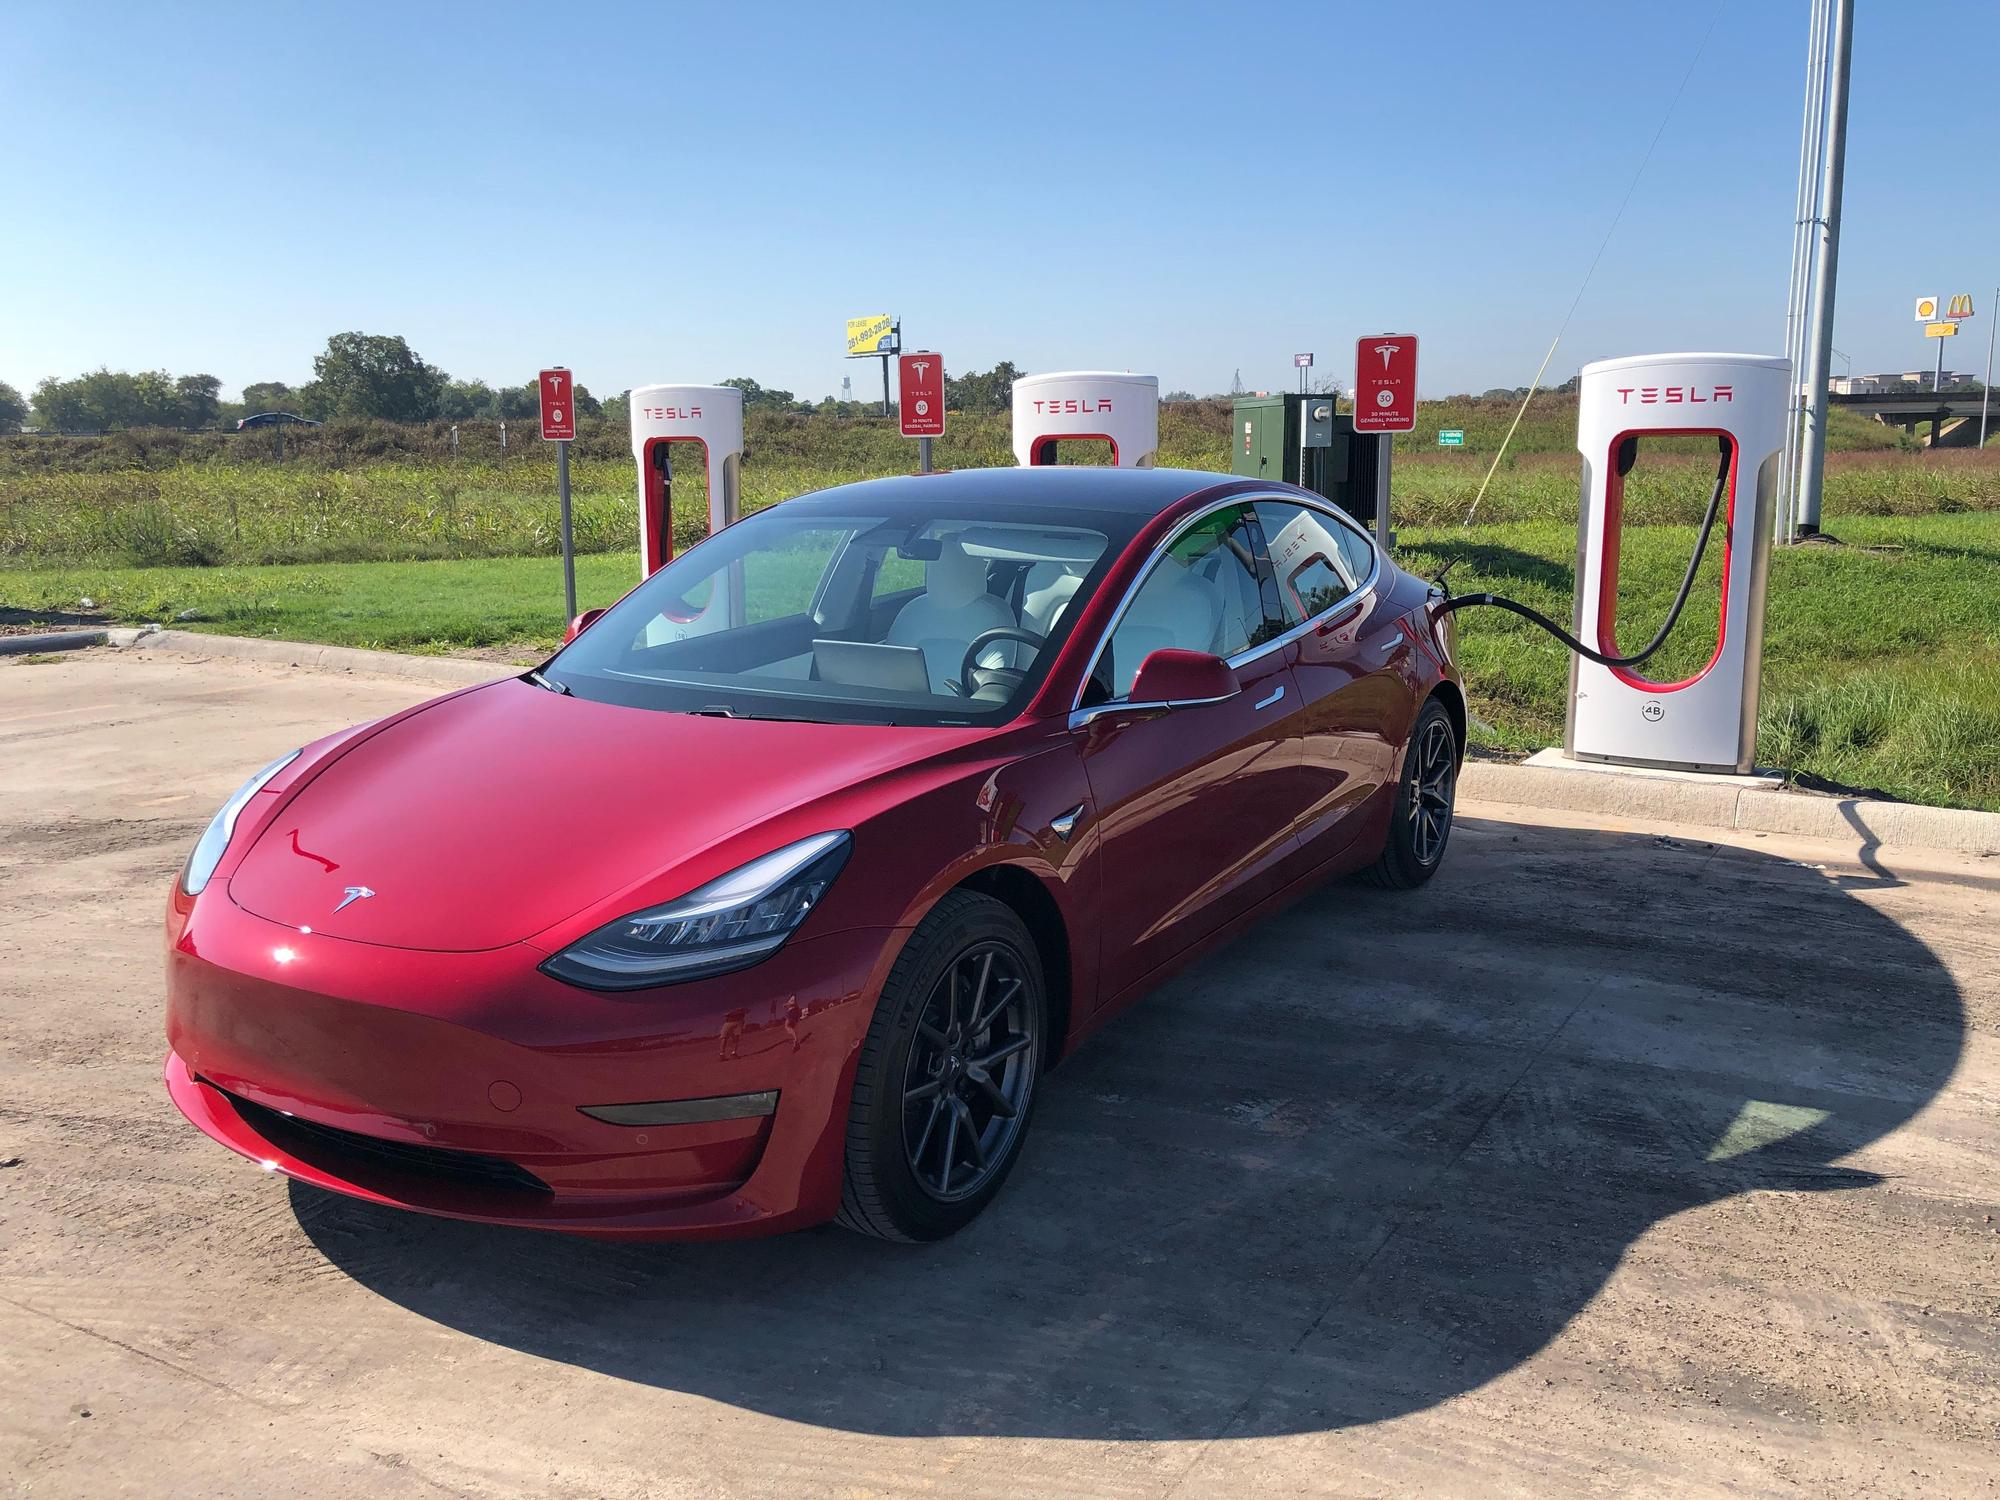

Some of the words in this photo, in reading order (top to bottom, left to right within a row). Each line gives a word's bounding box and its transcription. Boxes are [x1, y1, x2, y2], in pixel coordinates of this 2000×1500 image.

[1379, 394, 1391, 402] 30
[1617, 386, 1733, 404] TESLA
[1033, 399, 1112, 414] TESLA
[643, 407, 702, 419] TESLA
[1645, 706, 1661, 715] 4B
